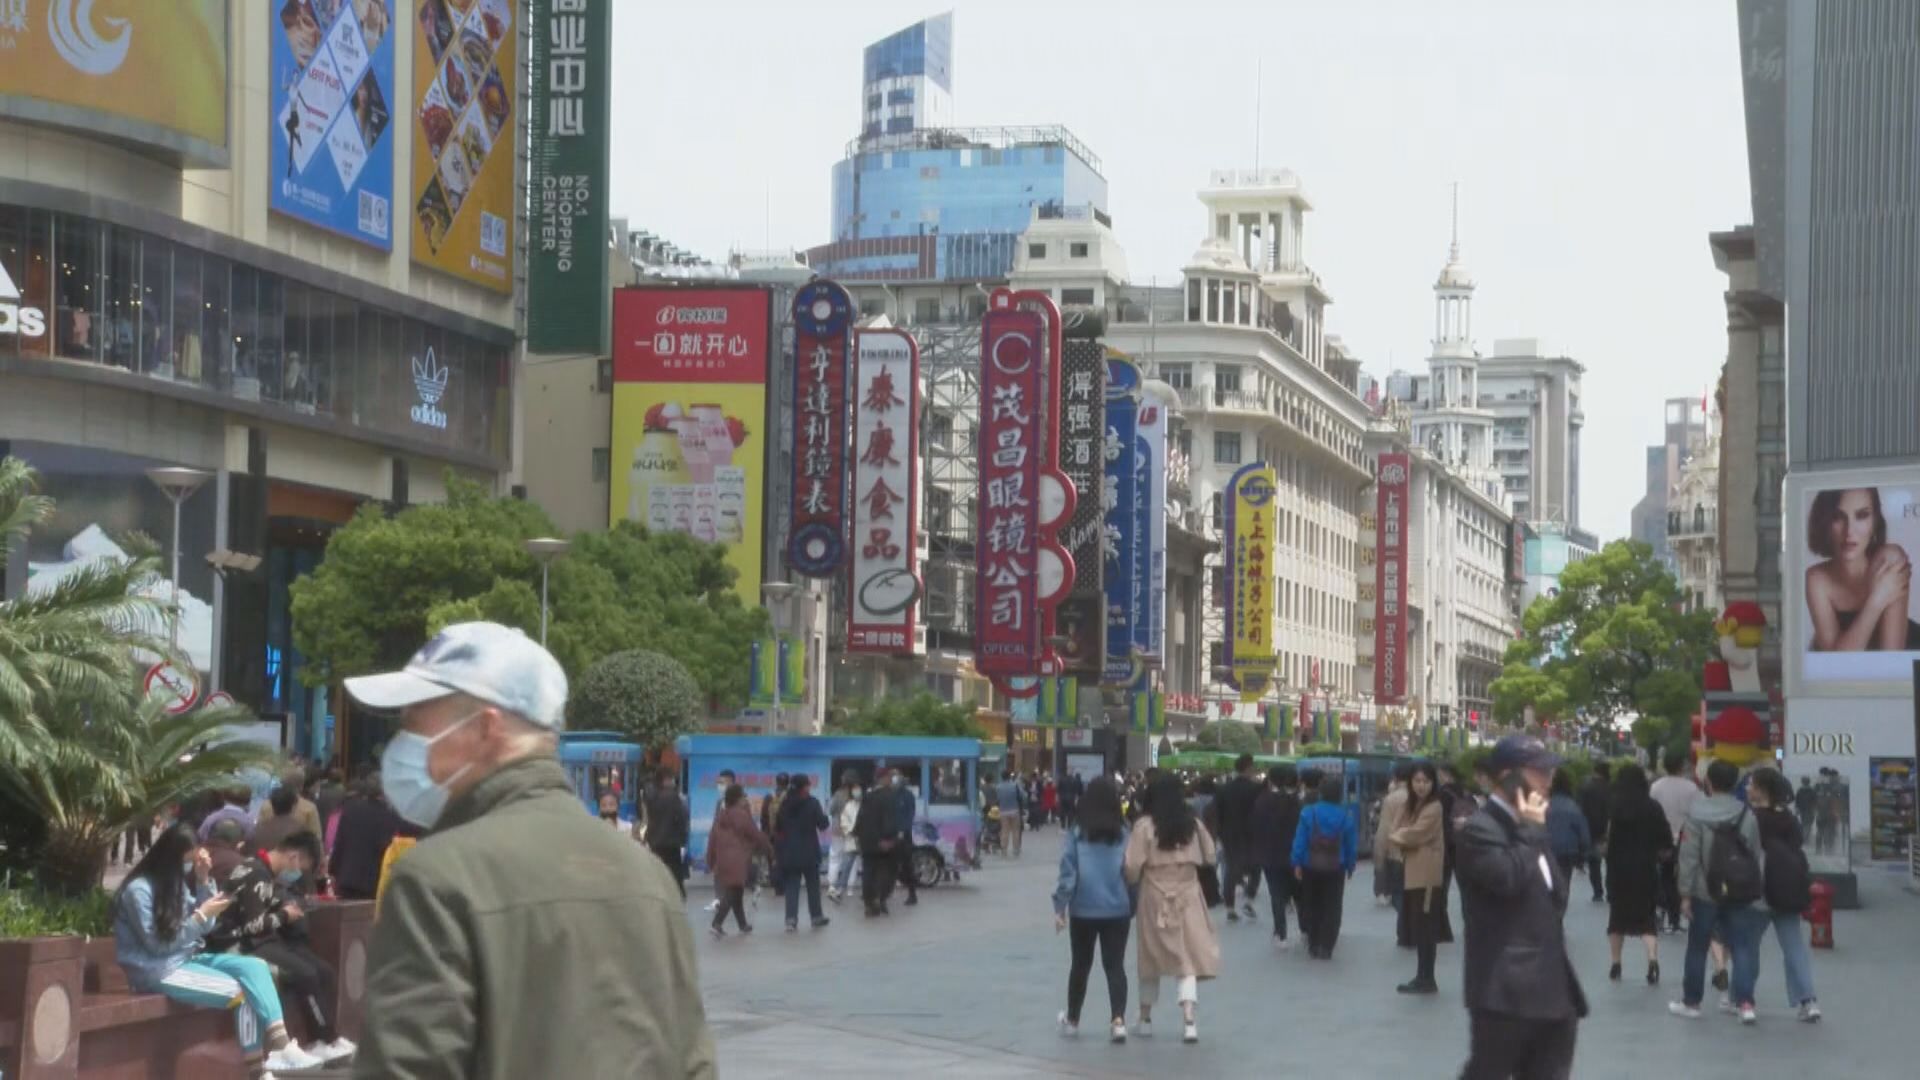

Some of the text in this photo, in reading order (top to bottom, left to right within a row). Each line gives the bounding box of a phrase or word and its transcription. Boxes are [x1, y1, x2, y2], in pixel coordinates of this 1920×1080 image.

[542, 175, 557, 251] CENTER
[557, 175, 573, 272] SHOPPING
[575, 175, 590, 215] NO.1
[411, 402, 448, 430] adidas
[860, 364, 905, 559] 泰康食品
[985, 382, 1030, 631] 茂昌眼镜公司
[983, 643, 1025, 655] OPTICAL
[1792, 732, 1856, 756] DIOR
